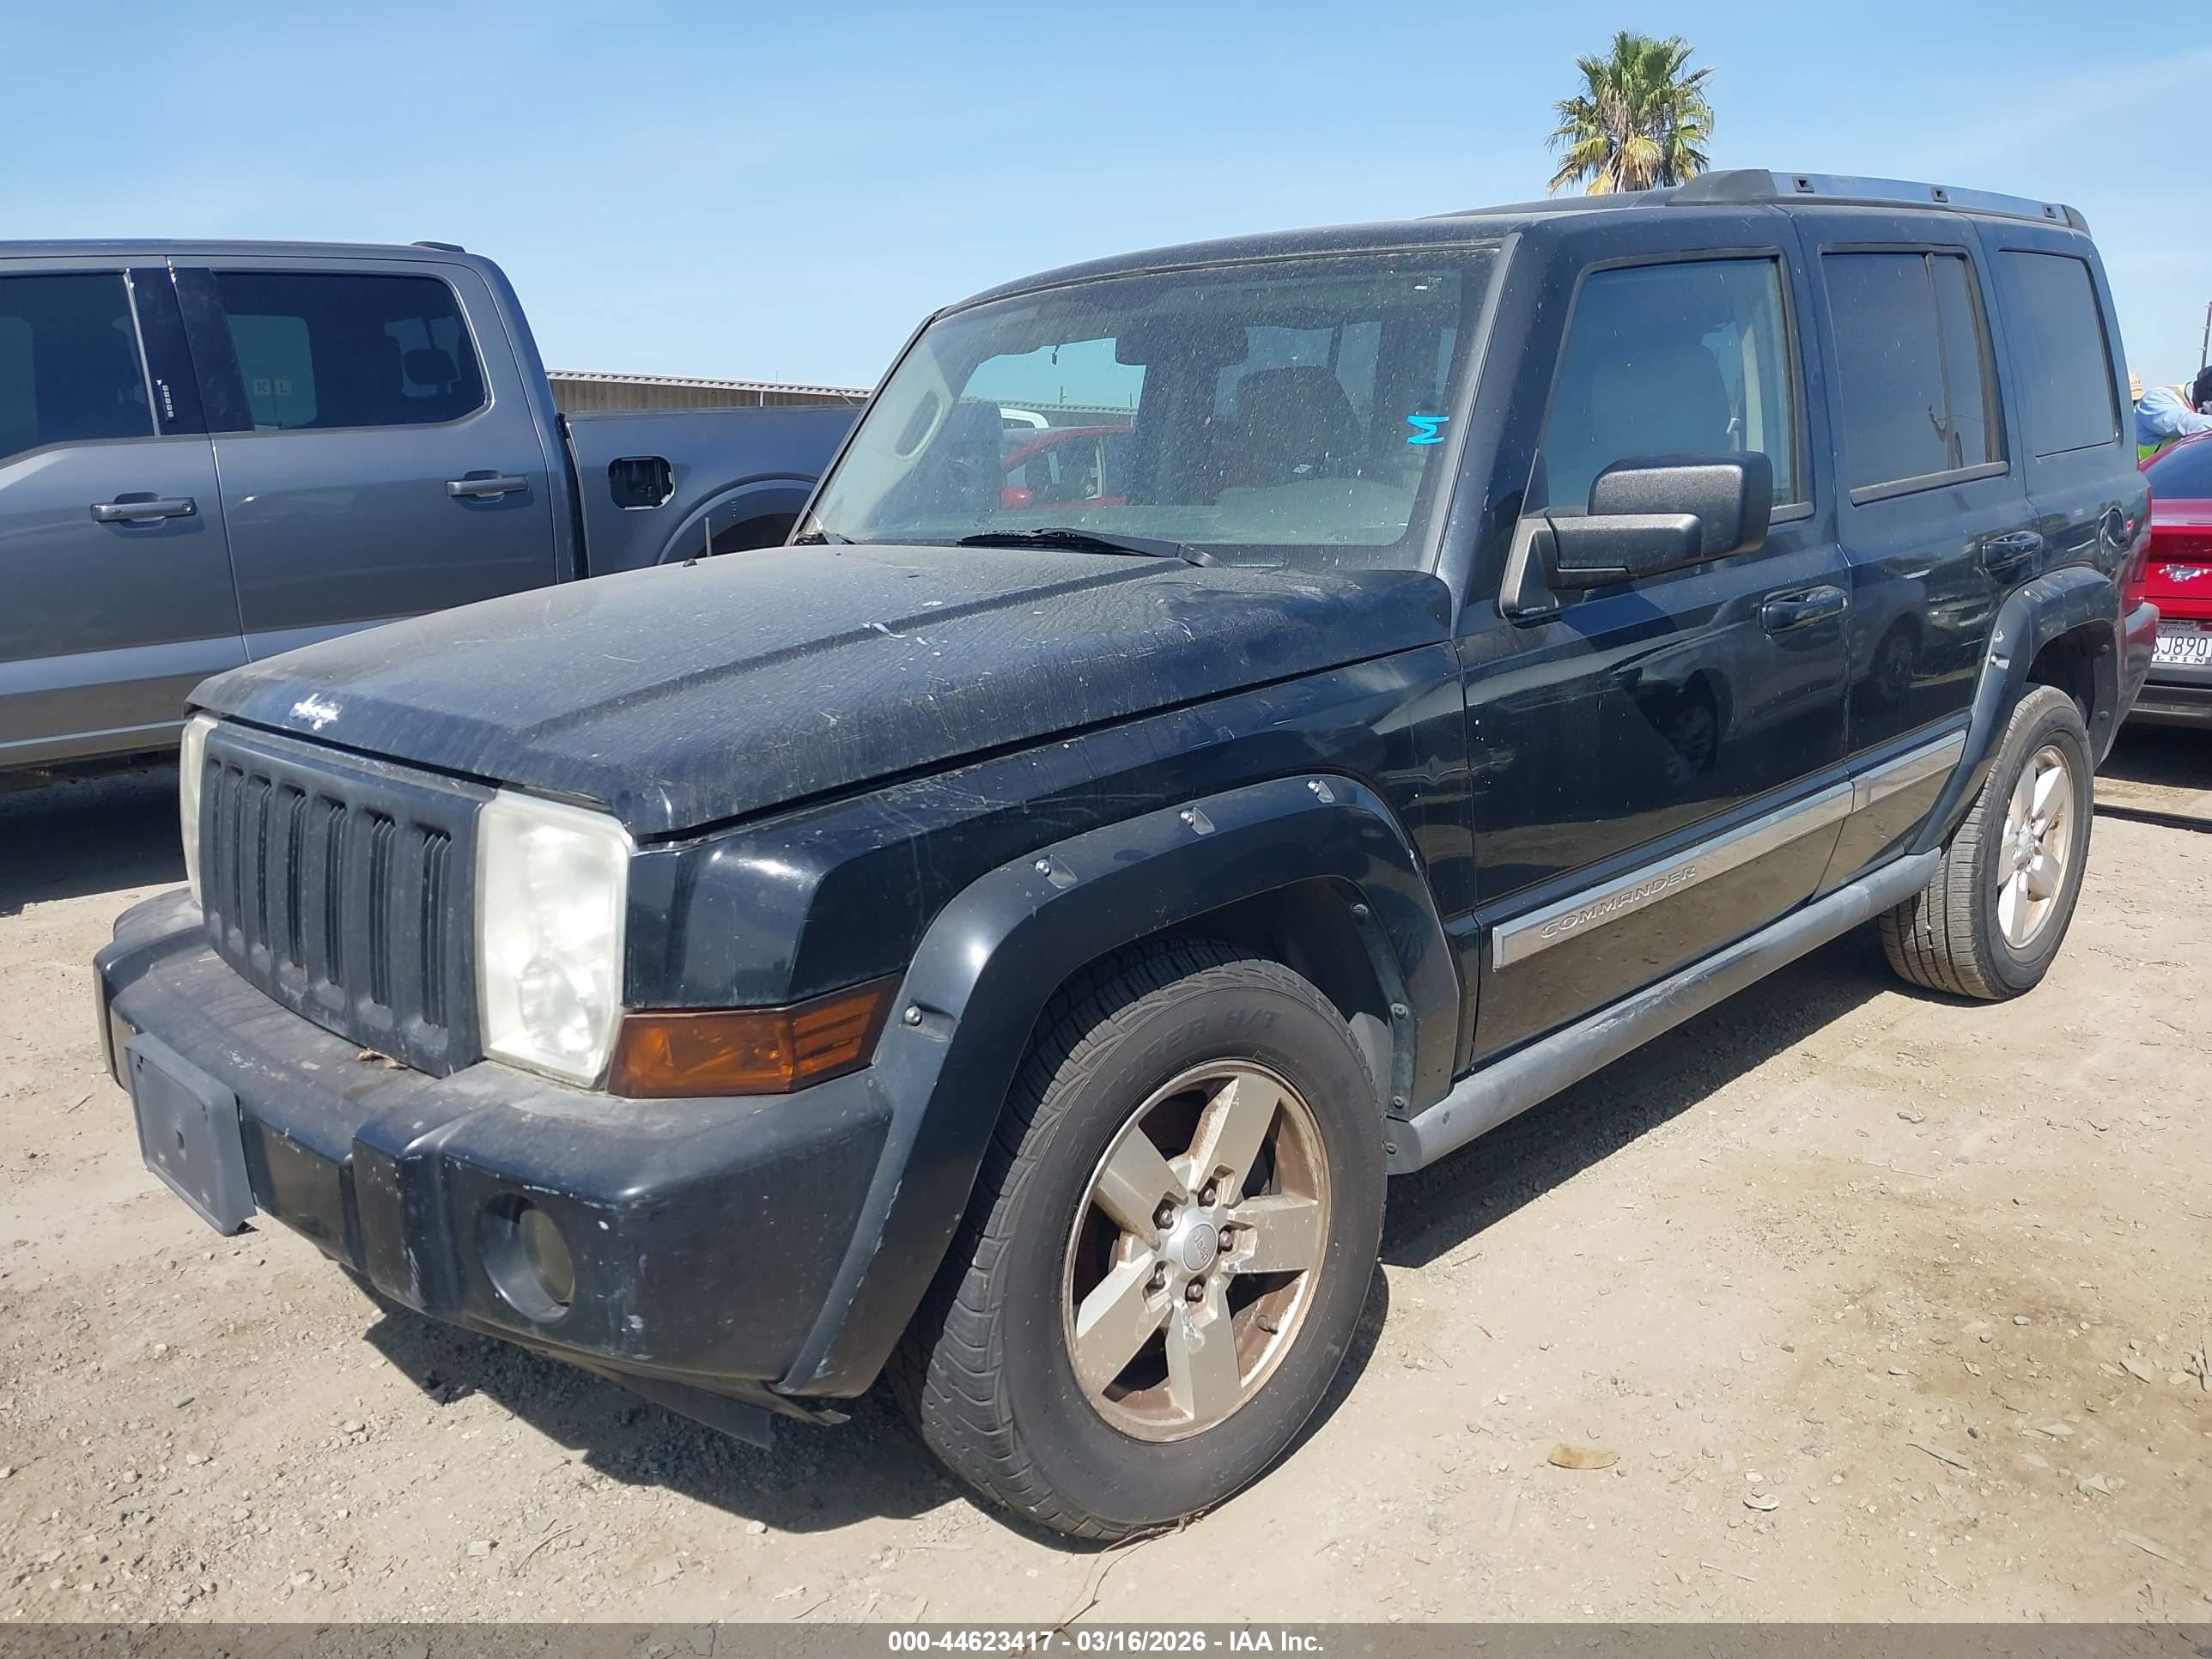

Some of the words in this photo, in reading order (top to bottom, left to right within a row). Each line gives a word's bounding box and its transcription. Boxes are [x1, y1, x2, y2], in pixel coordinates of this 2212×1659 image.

[257, 380, 268, 392] K
[279, 381, 289, 393] L
[1540, 865, 1698, 939] COMMANDER
